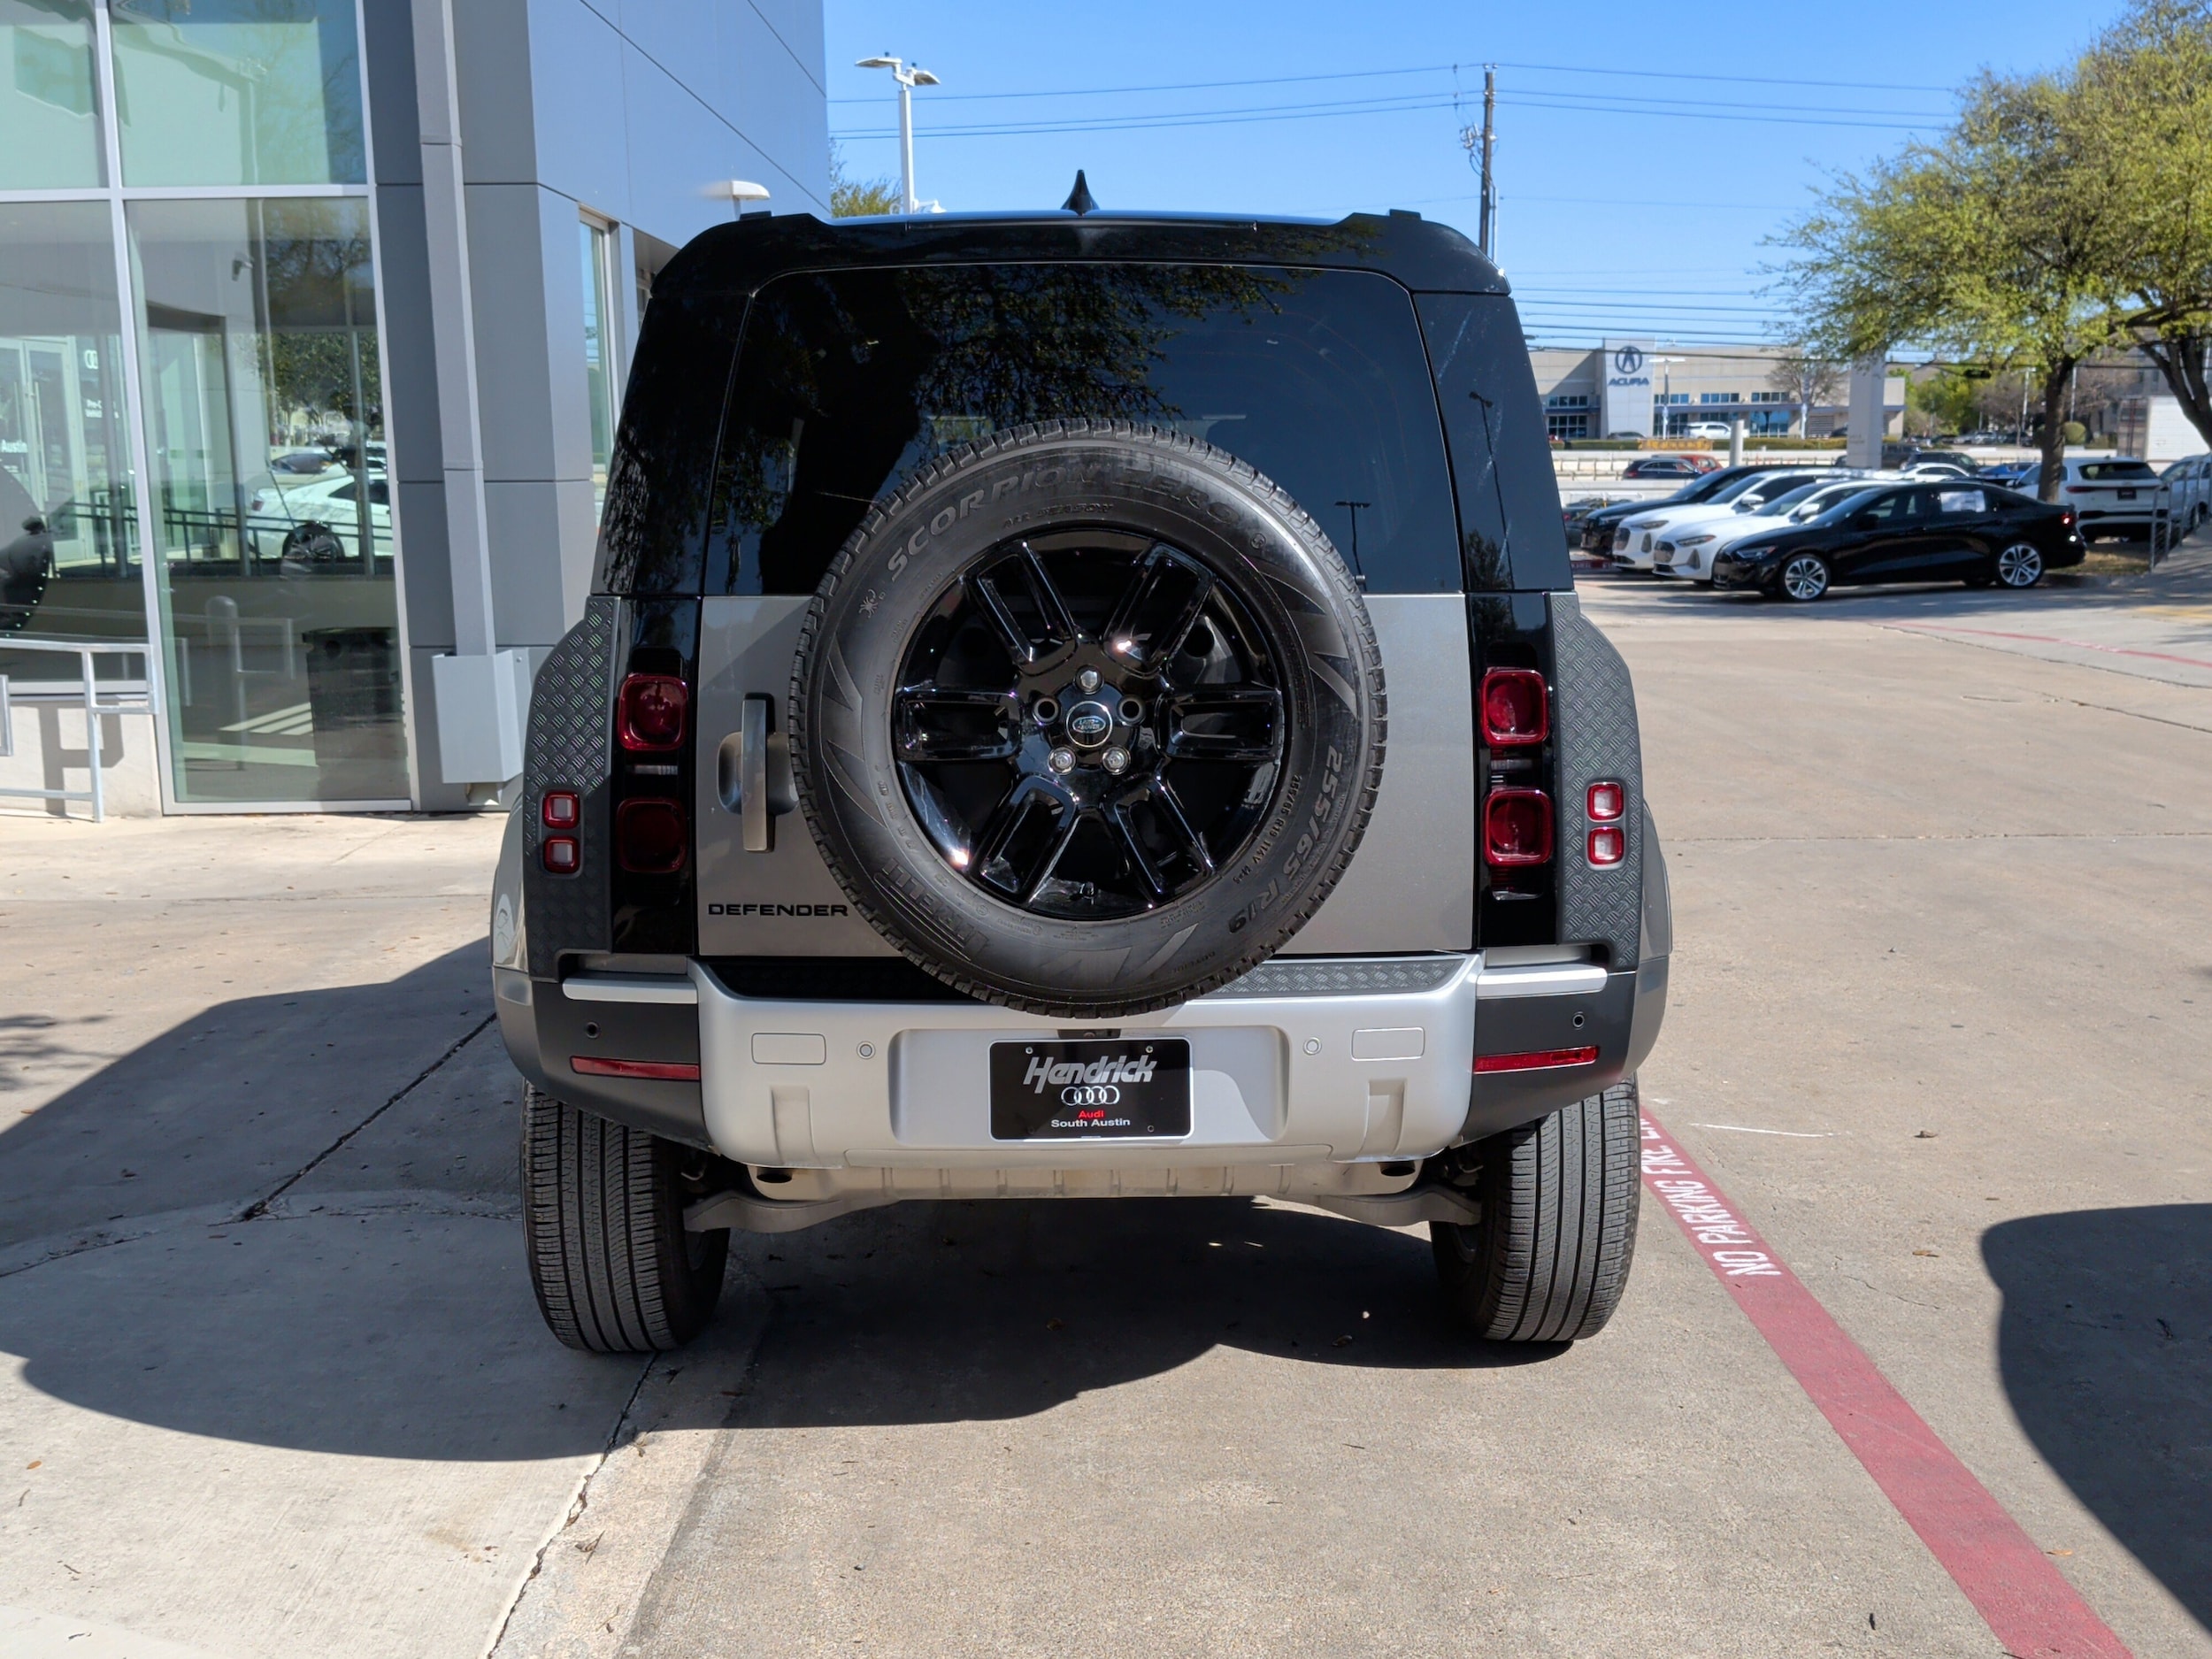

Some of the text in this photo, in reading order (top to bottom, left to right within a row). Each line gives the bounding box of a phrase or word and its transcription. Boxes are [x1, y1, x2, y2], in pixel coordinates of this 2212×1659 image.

[1609, 377, 1650, 387] ACURA
[887, 465, 1102, 582] SCORPION
[1283, 744, 1343, 882] 255/65
[708, 903, 849, 917] DEFENDER
[1228, 878, 1281, 933] R19
[1023, 1055, 1157, 1094] Hendrick
[1050, 1118, 1131, 1128] South Austin
[1078, 1110, 1104, 1118] Audi
[1653, 1179, 1754, 1244] PARKING
[1712, 1250, 1782, 1275] NO
